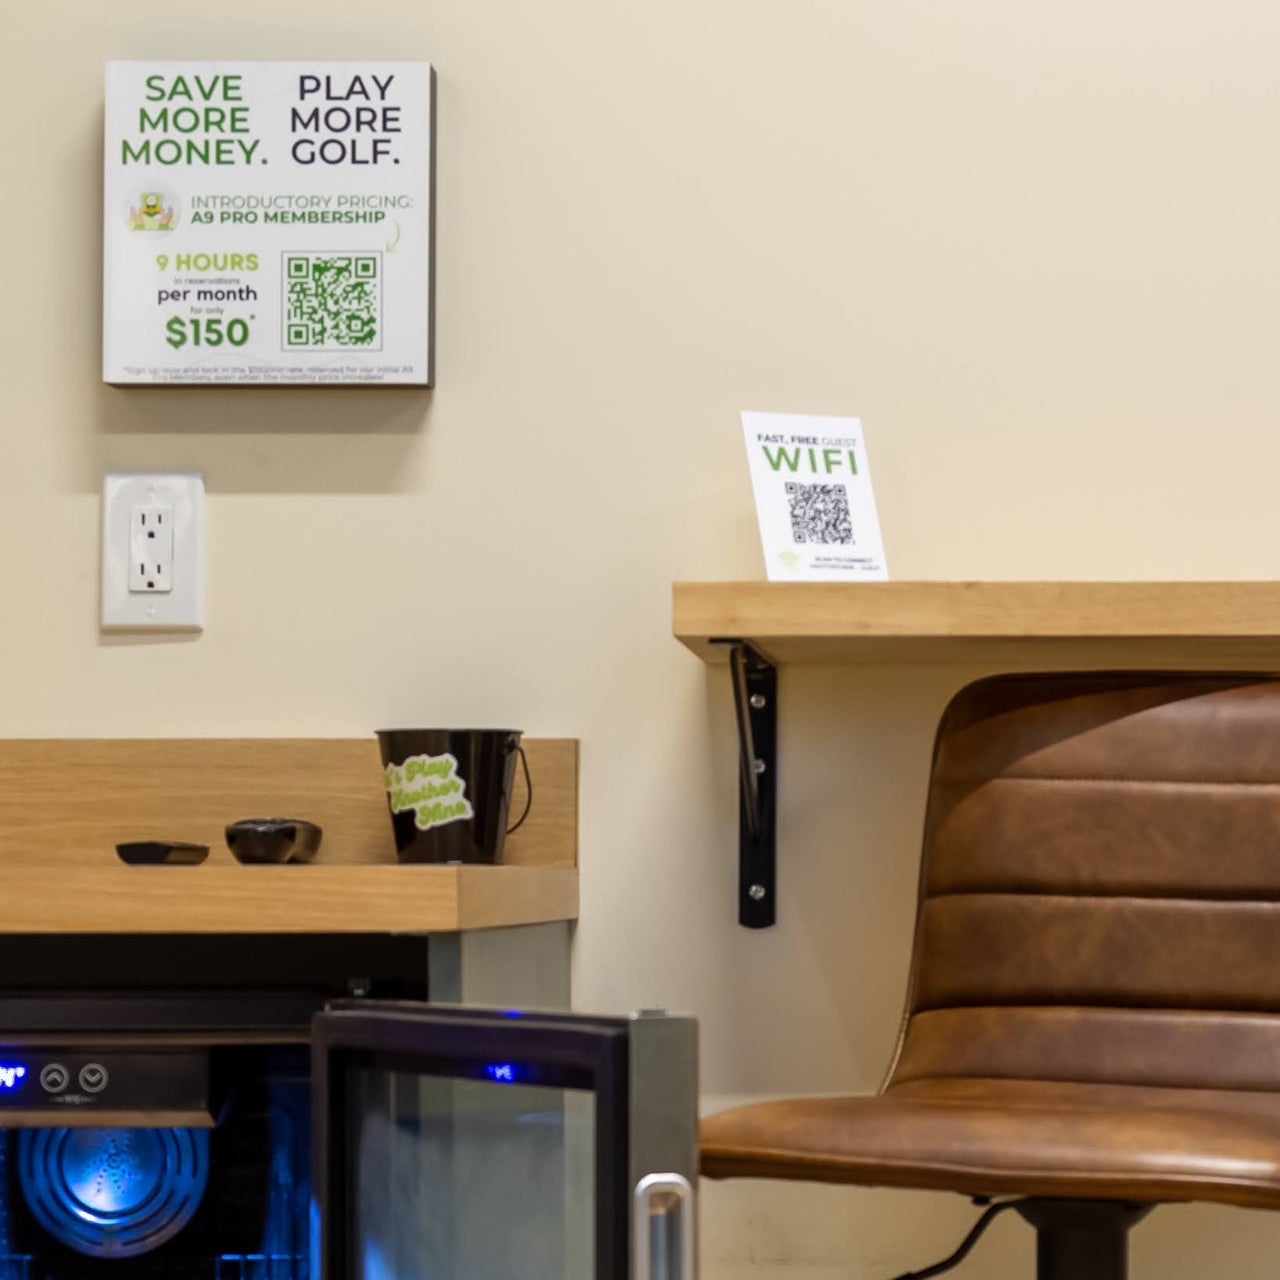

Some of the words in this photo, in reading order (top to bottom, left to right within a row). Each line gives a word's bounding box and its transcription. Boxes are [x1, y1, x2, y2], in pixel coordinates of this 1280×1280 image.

[145, 75, 242, 101] SAVE
[299, 75, 395, 101] PLAY
[139, 107, 250, 133] MORE
[291, 107, 402, 133] MORE
[121, 139, 268, 165] MONEY.
[291, 139, 400, 165] GOLF.
[190, 195, 332, 209] INTRODUCTORY
[337, 195, 414, 209] PRICING:
[190, 211, 214, 224] A9
[220, 211, 258, 224] PRO
[263, 211, 386, 224] MEMBERSHIP
[156, 254, 169, 271] 9
[175, 253, 259, 271] HOURS
[157, 289, 191, 305] per
[196, 284, 258, 301] month
[757, 434, 789, 445] FAST,
[791, 435, 819, 445] FREE
[821, 438, 857, 447] GUEST
[762, 444, 858, 475] WIFI
